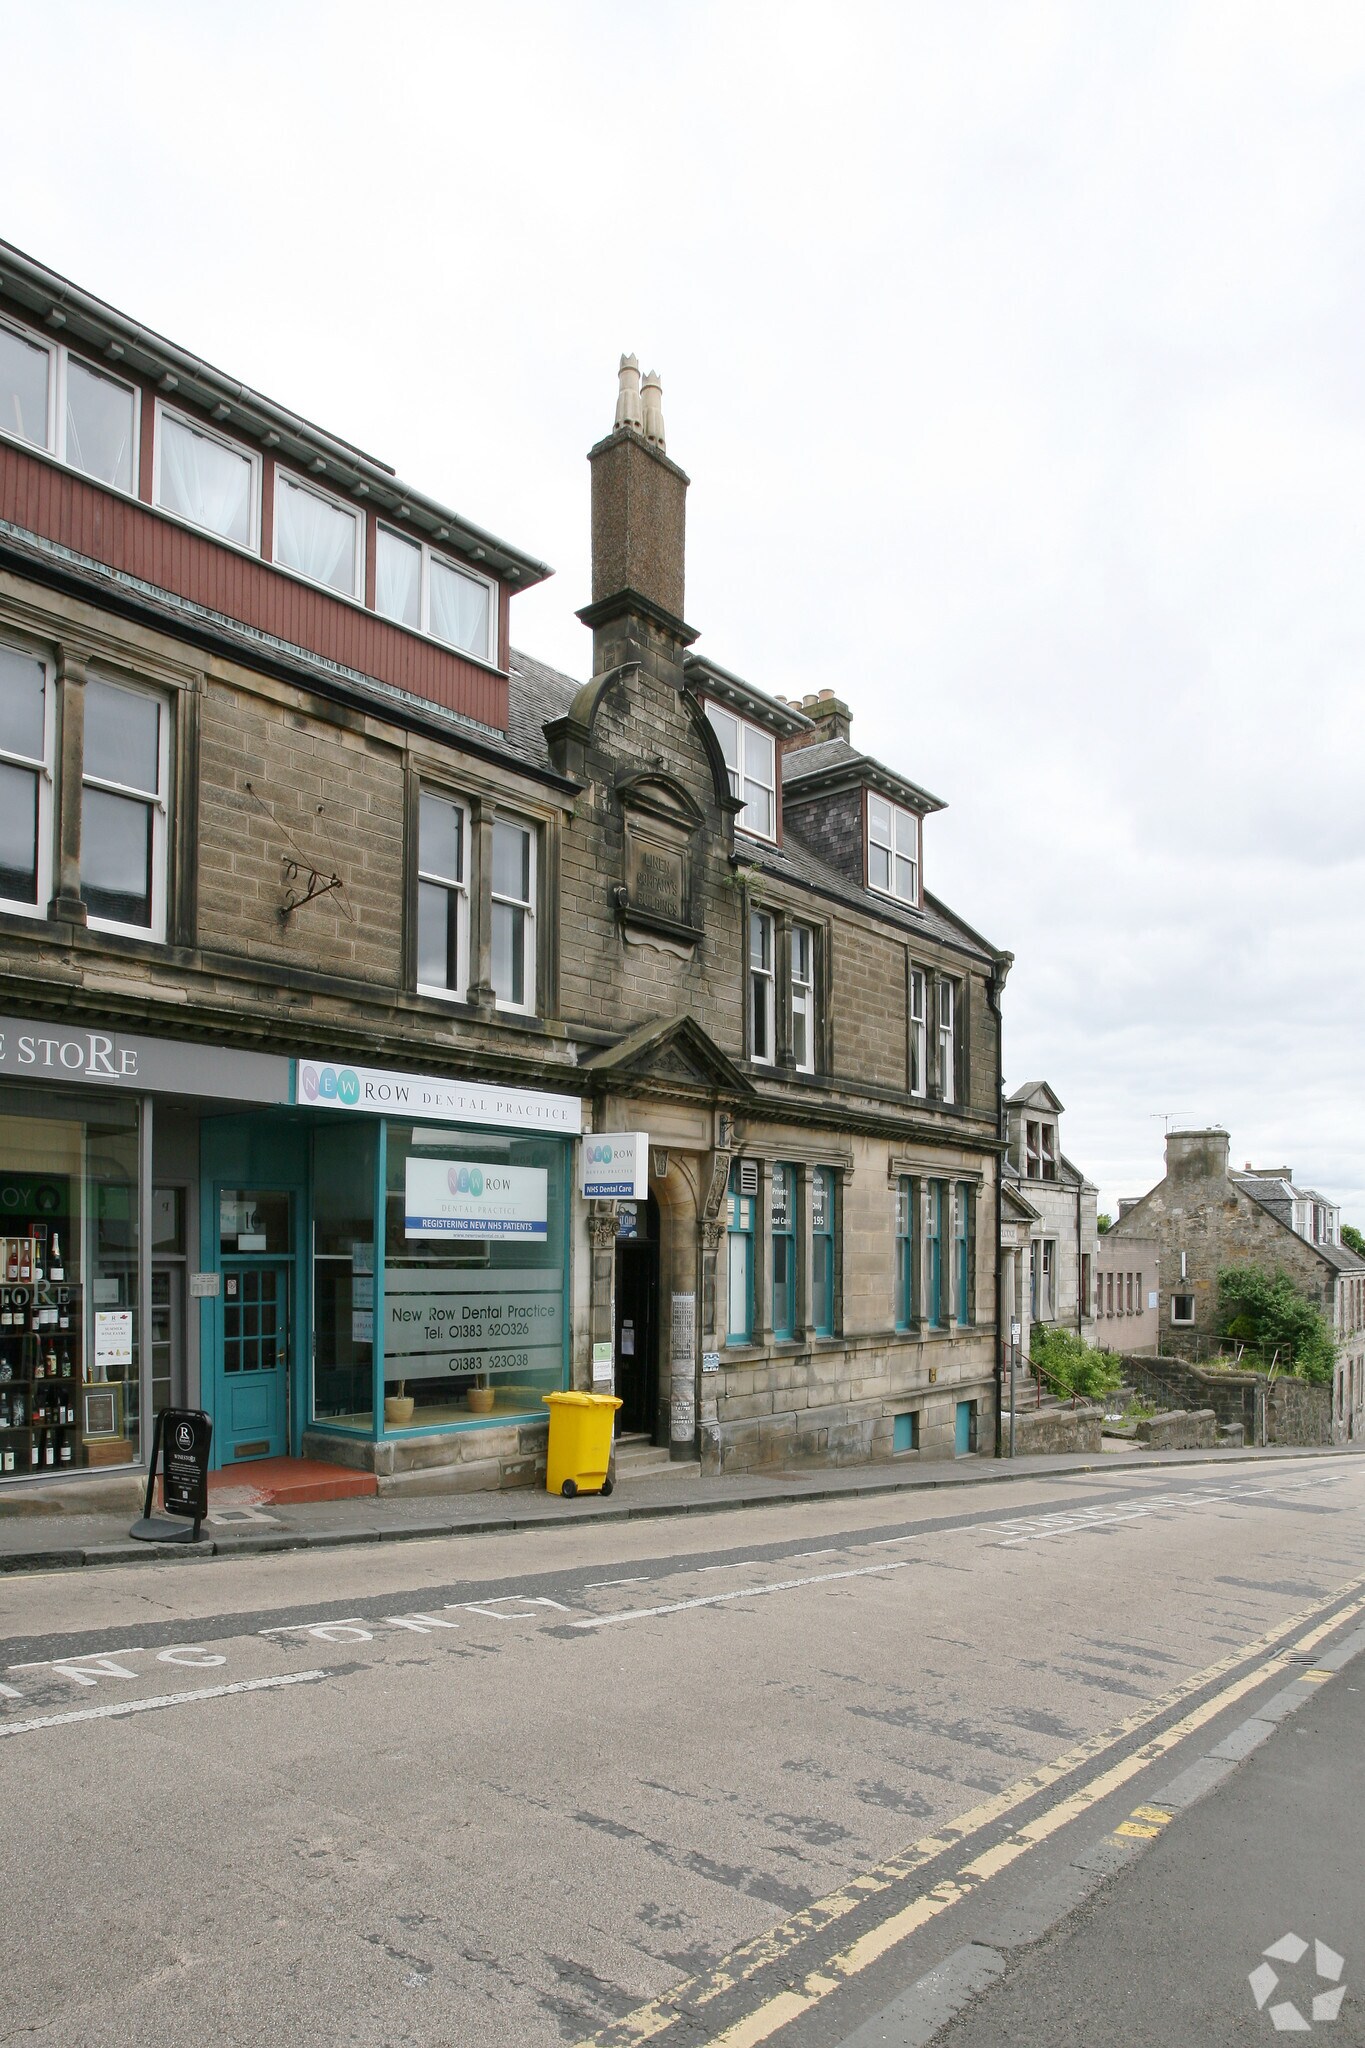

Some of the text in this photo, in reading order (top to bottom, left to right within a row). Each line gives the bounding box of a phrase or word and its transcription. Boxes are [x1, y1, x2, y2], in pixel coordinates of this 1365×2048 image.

[645, 852, 670, 875] LINEN
[637, 872, 678, 896] COMPANY'S
[637, 891, 678, 916] BUILDINGS
[18, 1034, 139, 1076] STORE
[365, 1082, 410, 1102] ROW
[423, 1092, 488, 1110] DENTAL
[496, 1102, 568, 1120] PRACTICE
[613, 1150, 633, 1159] ROW
[486, 1178, 511, 1191] ROW
[586, 1185, 632, 1193] NHS Dental Care
[441, 1204, 516, 1215] DENTAL PRACTICE
[422, 1219, 533, 1231] REGISTERING NEW NHS PATIENTS
[392, 1304, 555, 1322] New Row Dental Practice
[424, 1323, 529, 1339] Tel: 01383 620326
[449, 1354, 529, 1371] 01383 623038
[180, 1426, 190, 1438] R
[308, 1597, 571, 1643] ONLY
